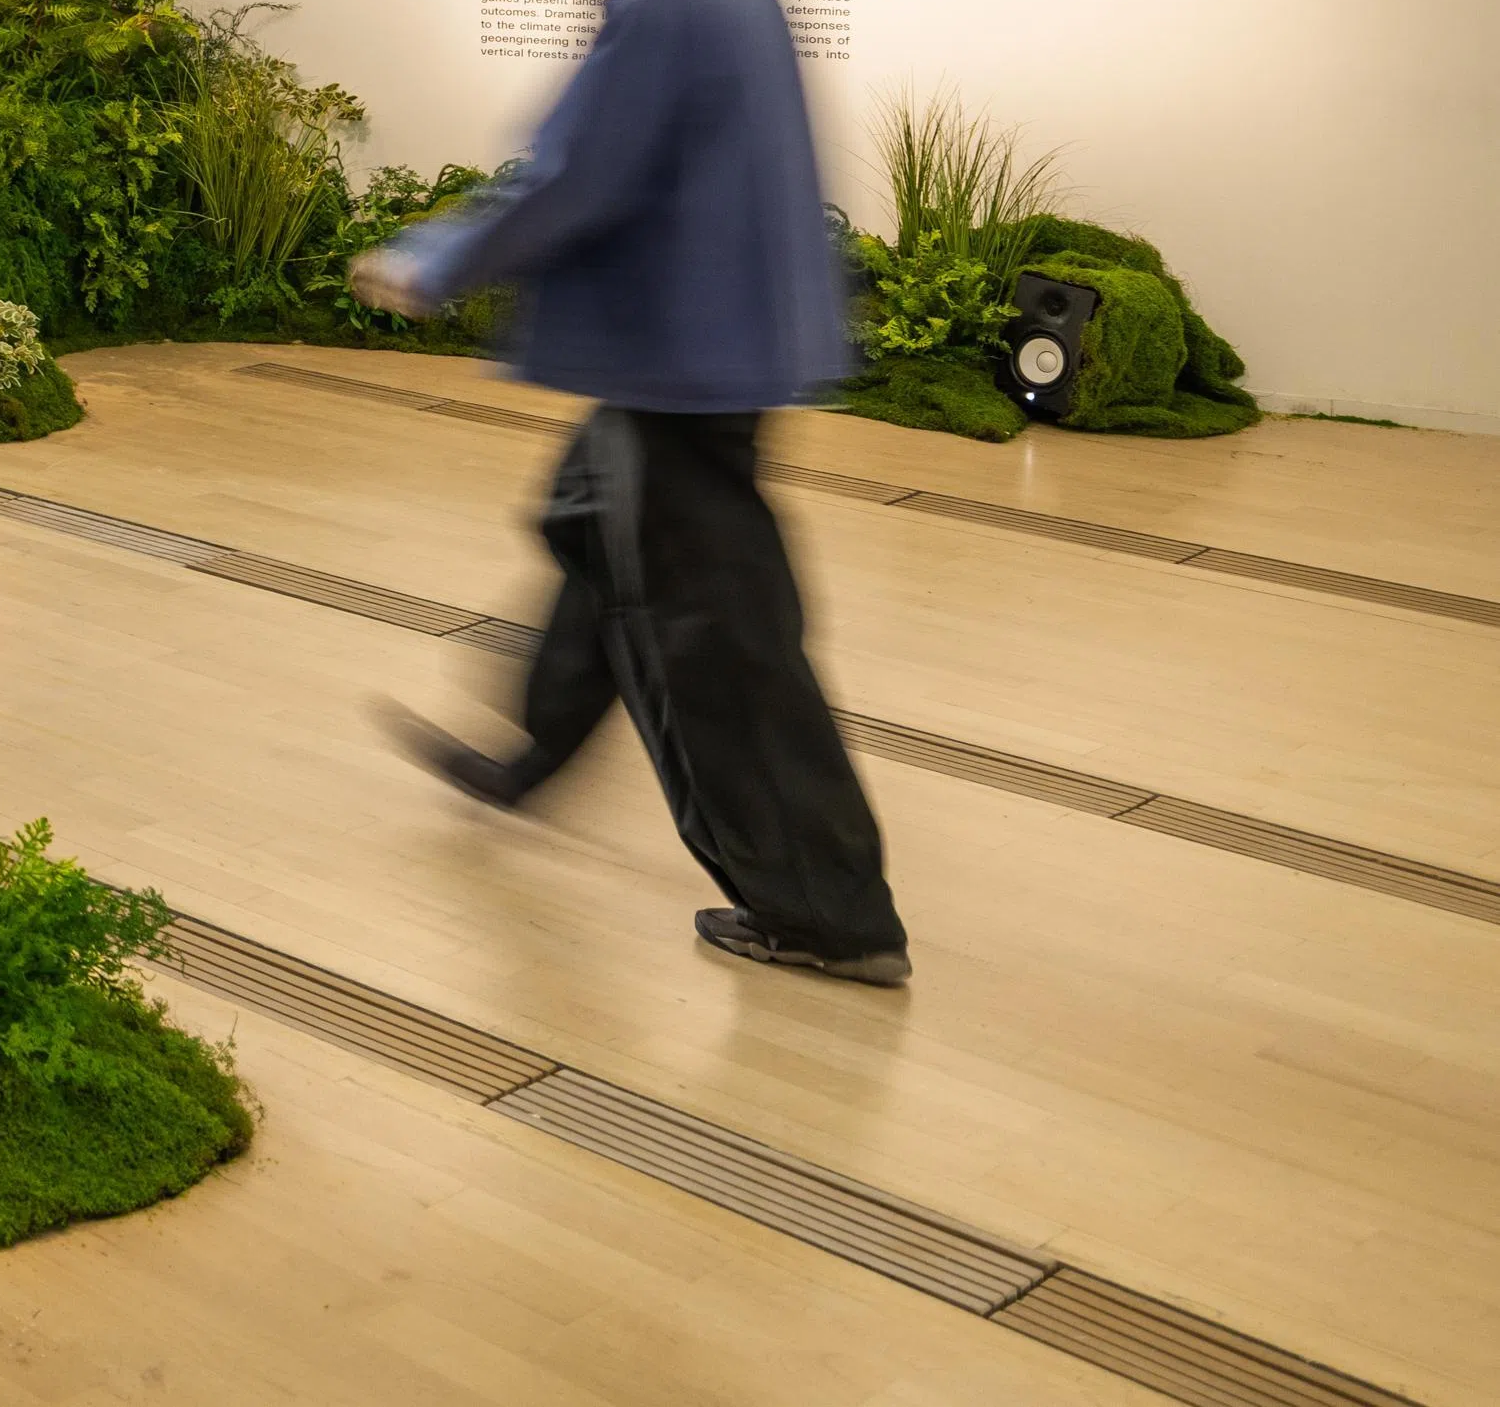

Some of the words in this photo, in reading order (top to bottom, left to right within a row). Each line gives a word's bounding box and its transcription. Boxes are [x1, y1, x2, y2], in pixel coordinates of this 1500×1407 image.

[480, 20, 493, 29] to
[496, 20, 516, 30] the
[519, 21, 562, 33] climate
[566, 23, 602, 37] crisis,
[480, 47, 524, 58] vertical
[527, 48, 569, 60] forests
